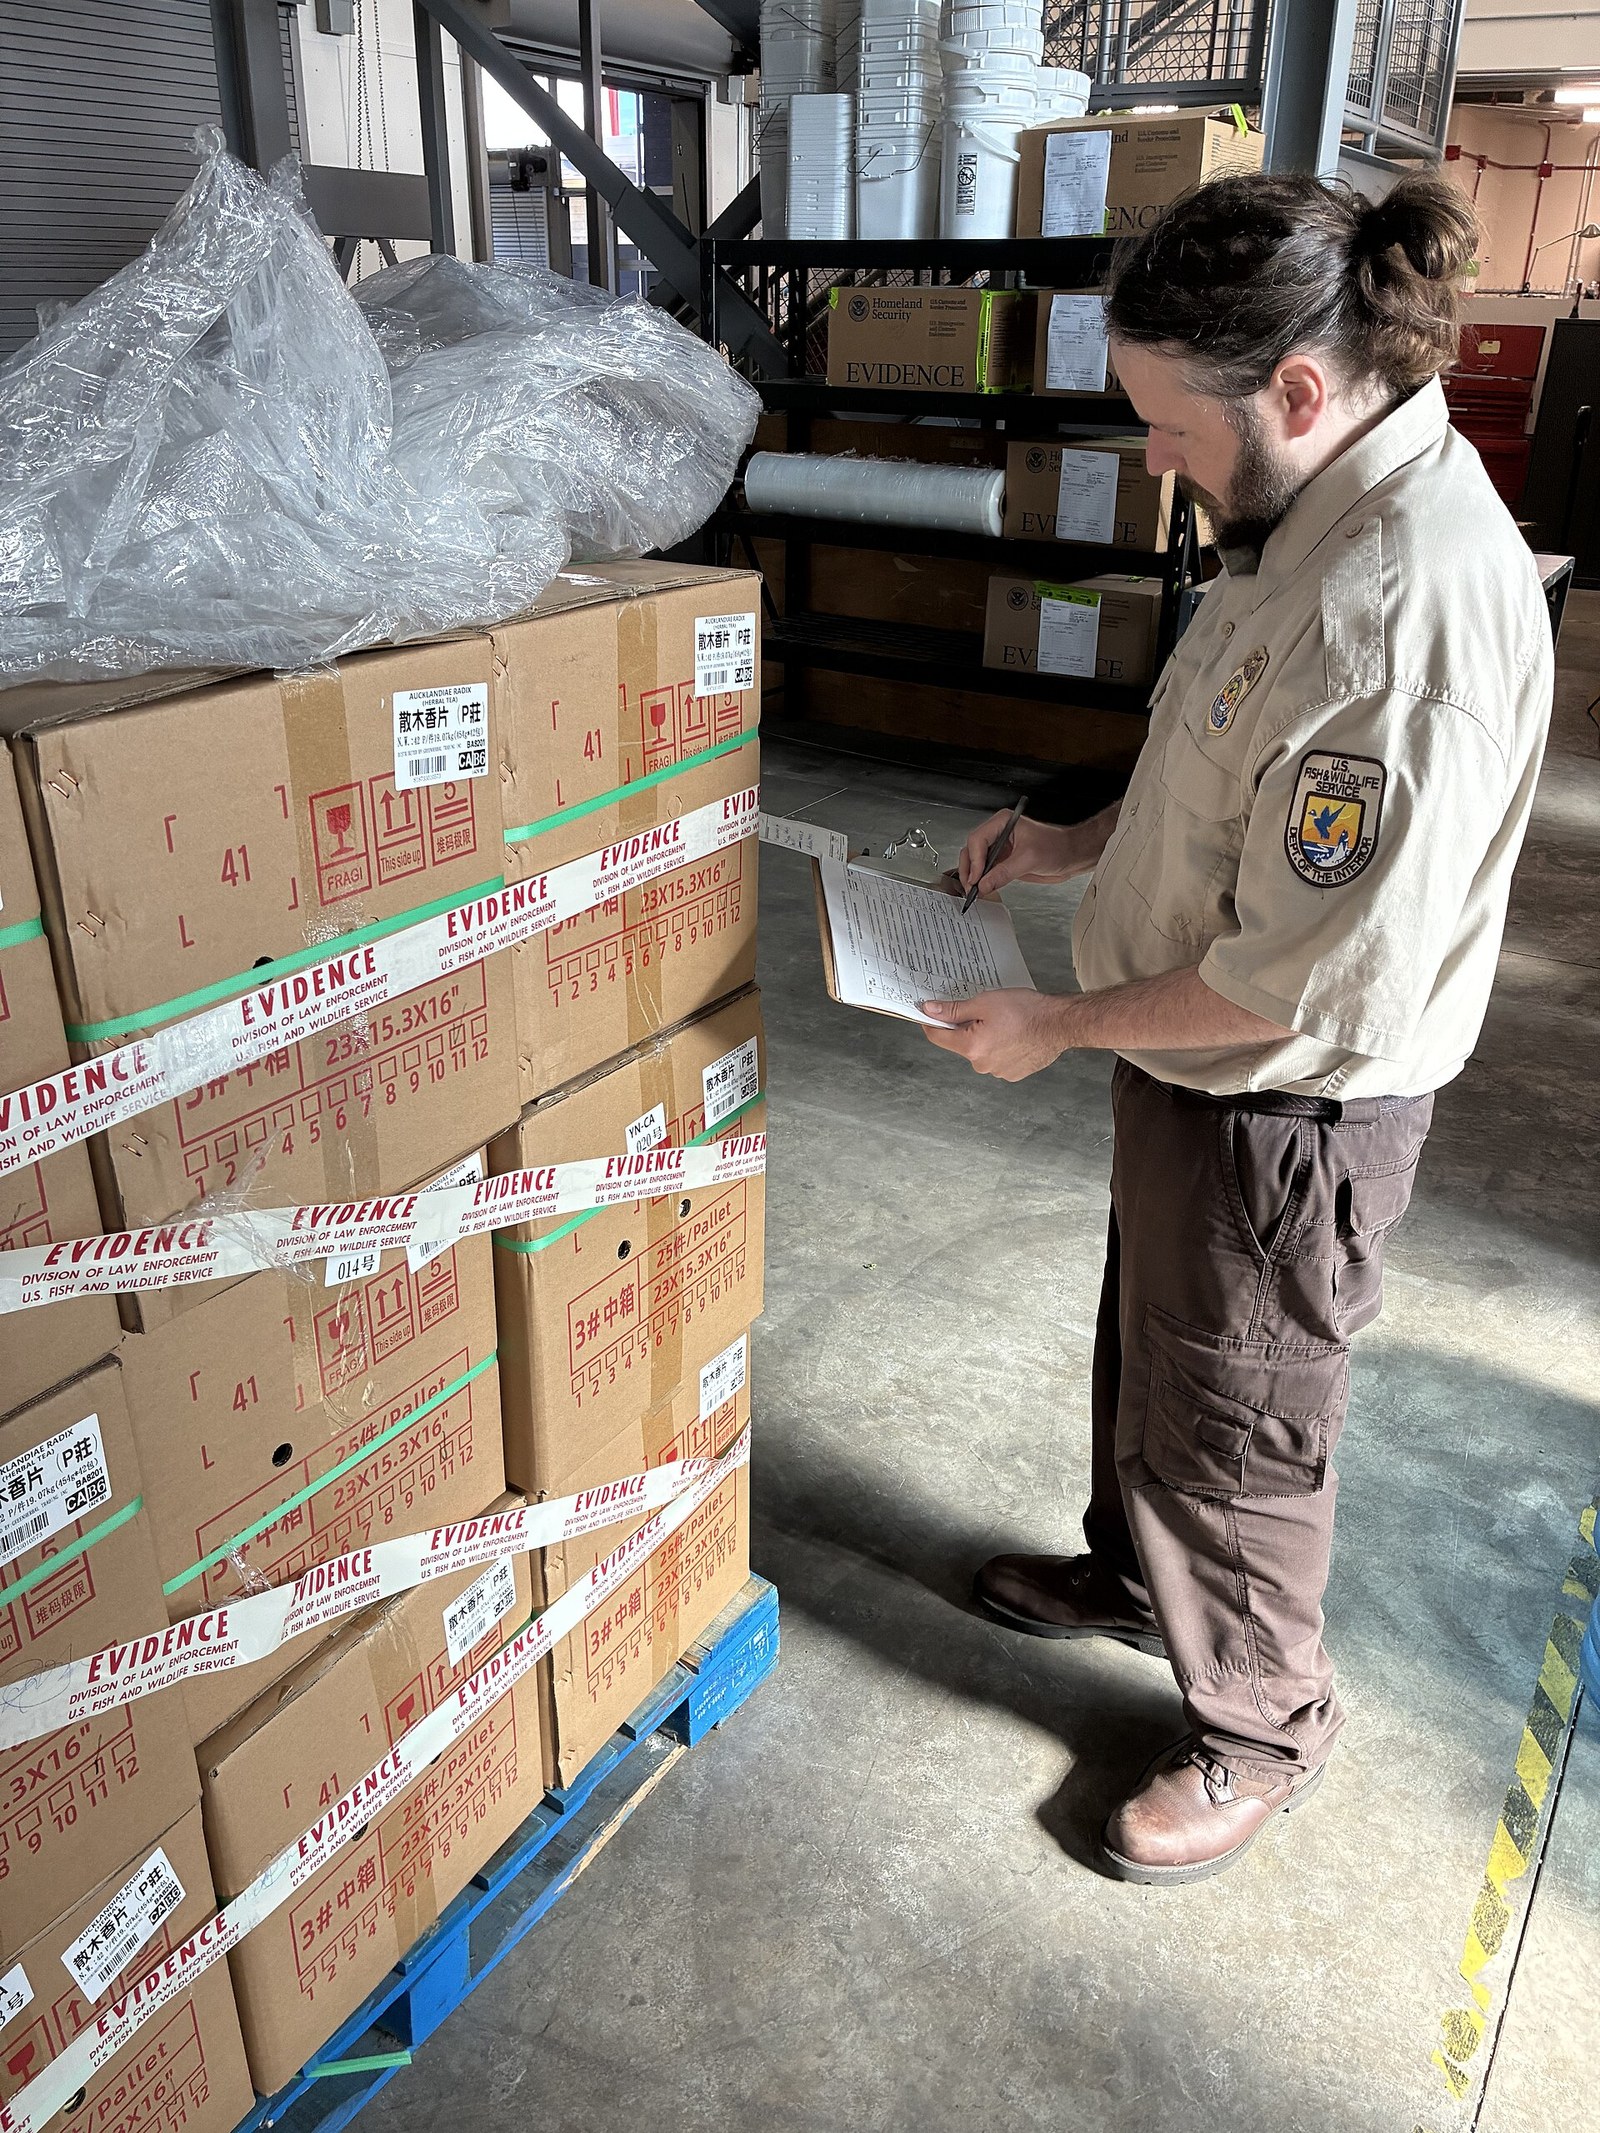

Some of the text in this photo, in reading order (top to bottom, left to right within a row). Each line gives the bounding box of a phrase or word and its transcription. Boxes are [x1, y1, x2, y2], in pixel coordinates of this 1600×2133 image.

[872, 298, 923, 309] Homeland
[872, 310, 911, 323] Security
[847, 363, 964, 386] EVIDENCE
[1021, 512, 1138, 544] EVCE
[1002, 645, 1124, 679] EVCE
[409, 687, 472, 700] AUCKLANDIAE RADIX
[422, 698, 445, 706] (HERBAL
[584, 729, 602, 761] 41
[1331, 759, 1349, 772] U.S.
[1315, 782, 1360, 797] SERVICE
[436, 829, 471, 854] 堆码极限
[600, 821, 680, 871] EVIDENCE
[1297, 859, 1311, 873] OF
[1311, 869, 1332, 882] THE
[1334, 837, 1372, 882] INTERIOR
[221, 845, 250, 887] 41
[326, 866, 363, 890] FRAGI
[380, 849, 421, 874] This side up
[447, 876, 548, 938] EVIDENCE
[240, 947, 376, 1026] EVIDENCE
[232, 973, 389, 1048] DIVISION OF LAW ENFORCEMENT
[258, 1037, 280, 1056] FISH
[283, 1025, 305, 1045] AND
[309, 1006, 351, 1034] WILDLIFE
[354, 989, 389, 1011] SERVICE
[23, 1071, 166, 1141] OF LAW ENFORCEMENT
[195, 1176, 205, 1198] 1
[226, 1161, 237, 1184] 2
[282, 1133, 294, 1155] 4
[310, 1119, 320, 1143] 5
[336, 1108, 347, 1130] 6
[386, 1083, 396, 1105] 8
[409, 1071, 419, 1092] 9
[428, 1059, 445, 1084] 10
[452, 1051, 467, 1072] 11
[474, 1038, 488, 1061] 12
[27, 1140, 55, 1159] AND
[62, 1111, 116, 1143] WILDLIFE
[629, 1114, 655, 1138] YN-CA
[605, 1149, 684, 1178] EVIDENCE
[474, 1168, 556, 1206] EVIDENCE
[292, 1196, 418, 1230] EVIDENCE
[44, 1220, 213, 1266] EVIDENCE
[22, 1252, 219, 1286] DIVISION OF LAW ENFORCEMENT
[50, 1285, 74, 1297] FISH
[80, 1282, 109, 1292] AND
[117, 1275, 168, 1289] WILDLIFE
[172, 1268, 213, 1281] SERVICE
[338, 1255, 375, 1280] 014号
[430, 1258, 441, 1277] 5
[424, 1293, 455, 1322] 堆码极限
[375, 1326, 411, 1355] This side up
[232, 1375, 258, 1412] 41
[46, 1428, 74, 1450] RADIX
[2, 1449, 55, 1483] (HERBAL TEA)
[76, 1467, 104, 1488] BA8201
[575, 1475, 646, 1512] EVIDENCE
[431, 1510, 526, 1550] EVIDENCE
[591, 1513, 662, 1586] EVIDENCE
[36, 1580, 86, 1625] 堆码极限
[1, 1635, 13, 1649] up
[88, 1610, 228, 1683] EVIDENCE
[69, 1680, 118, 1705] DIVISION
[122, 1673, 137, 1687] OF
[141, 1664, 166, 1679] LAW
[169, 1640, 239, 1668] ENFORCEMENT
[458, 1618, 544, 1708] EVIDENCE
[92, 1696, 114, 1711] FISH
[119, 1686, 142, 1701] AND
[148, 1667, 188, 1689] WILDLIFE
[193, 1656, 236, 1672] SERVICE
[28, 1756, 140, 1854] 9 10 11 12
[298, 1748, 403, 1859] EVIDENCE
[318, 1772, 340, 1807] 41
[290, 1842, 325, 1878] DIVISION
[328, 1830, 337, 1842] OF
[341, 1810, 359, 1829] LAW
[362, 1761, 412, 1810] ENFORCEMENT
[310, 1854, 327, 1871] FISH
[329, 1834, 347, 1851] AND
[350, 1800, 383, 1833] WILDLIFE
[385, 1771, 413, 1799] SERVICE
[78, 1869, 145, 1944] AUCKLANDIAE RADIX
[89, 1923, 240, 2060] DIVISION OF LAW ENFORCEMENT
[96, 1912, 226, 2037] EVIDENCE
[114, 2026, 133, 2048] FISH
[137, 2004, 156, 2025] AND
[160, 1966, 202, 2002] WILDLIFE
[206, 1934, 240, 1965] SERVICE
